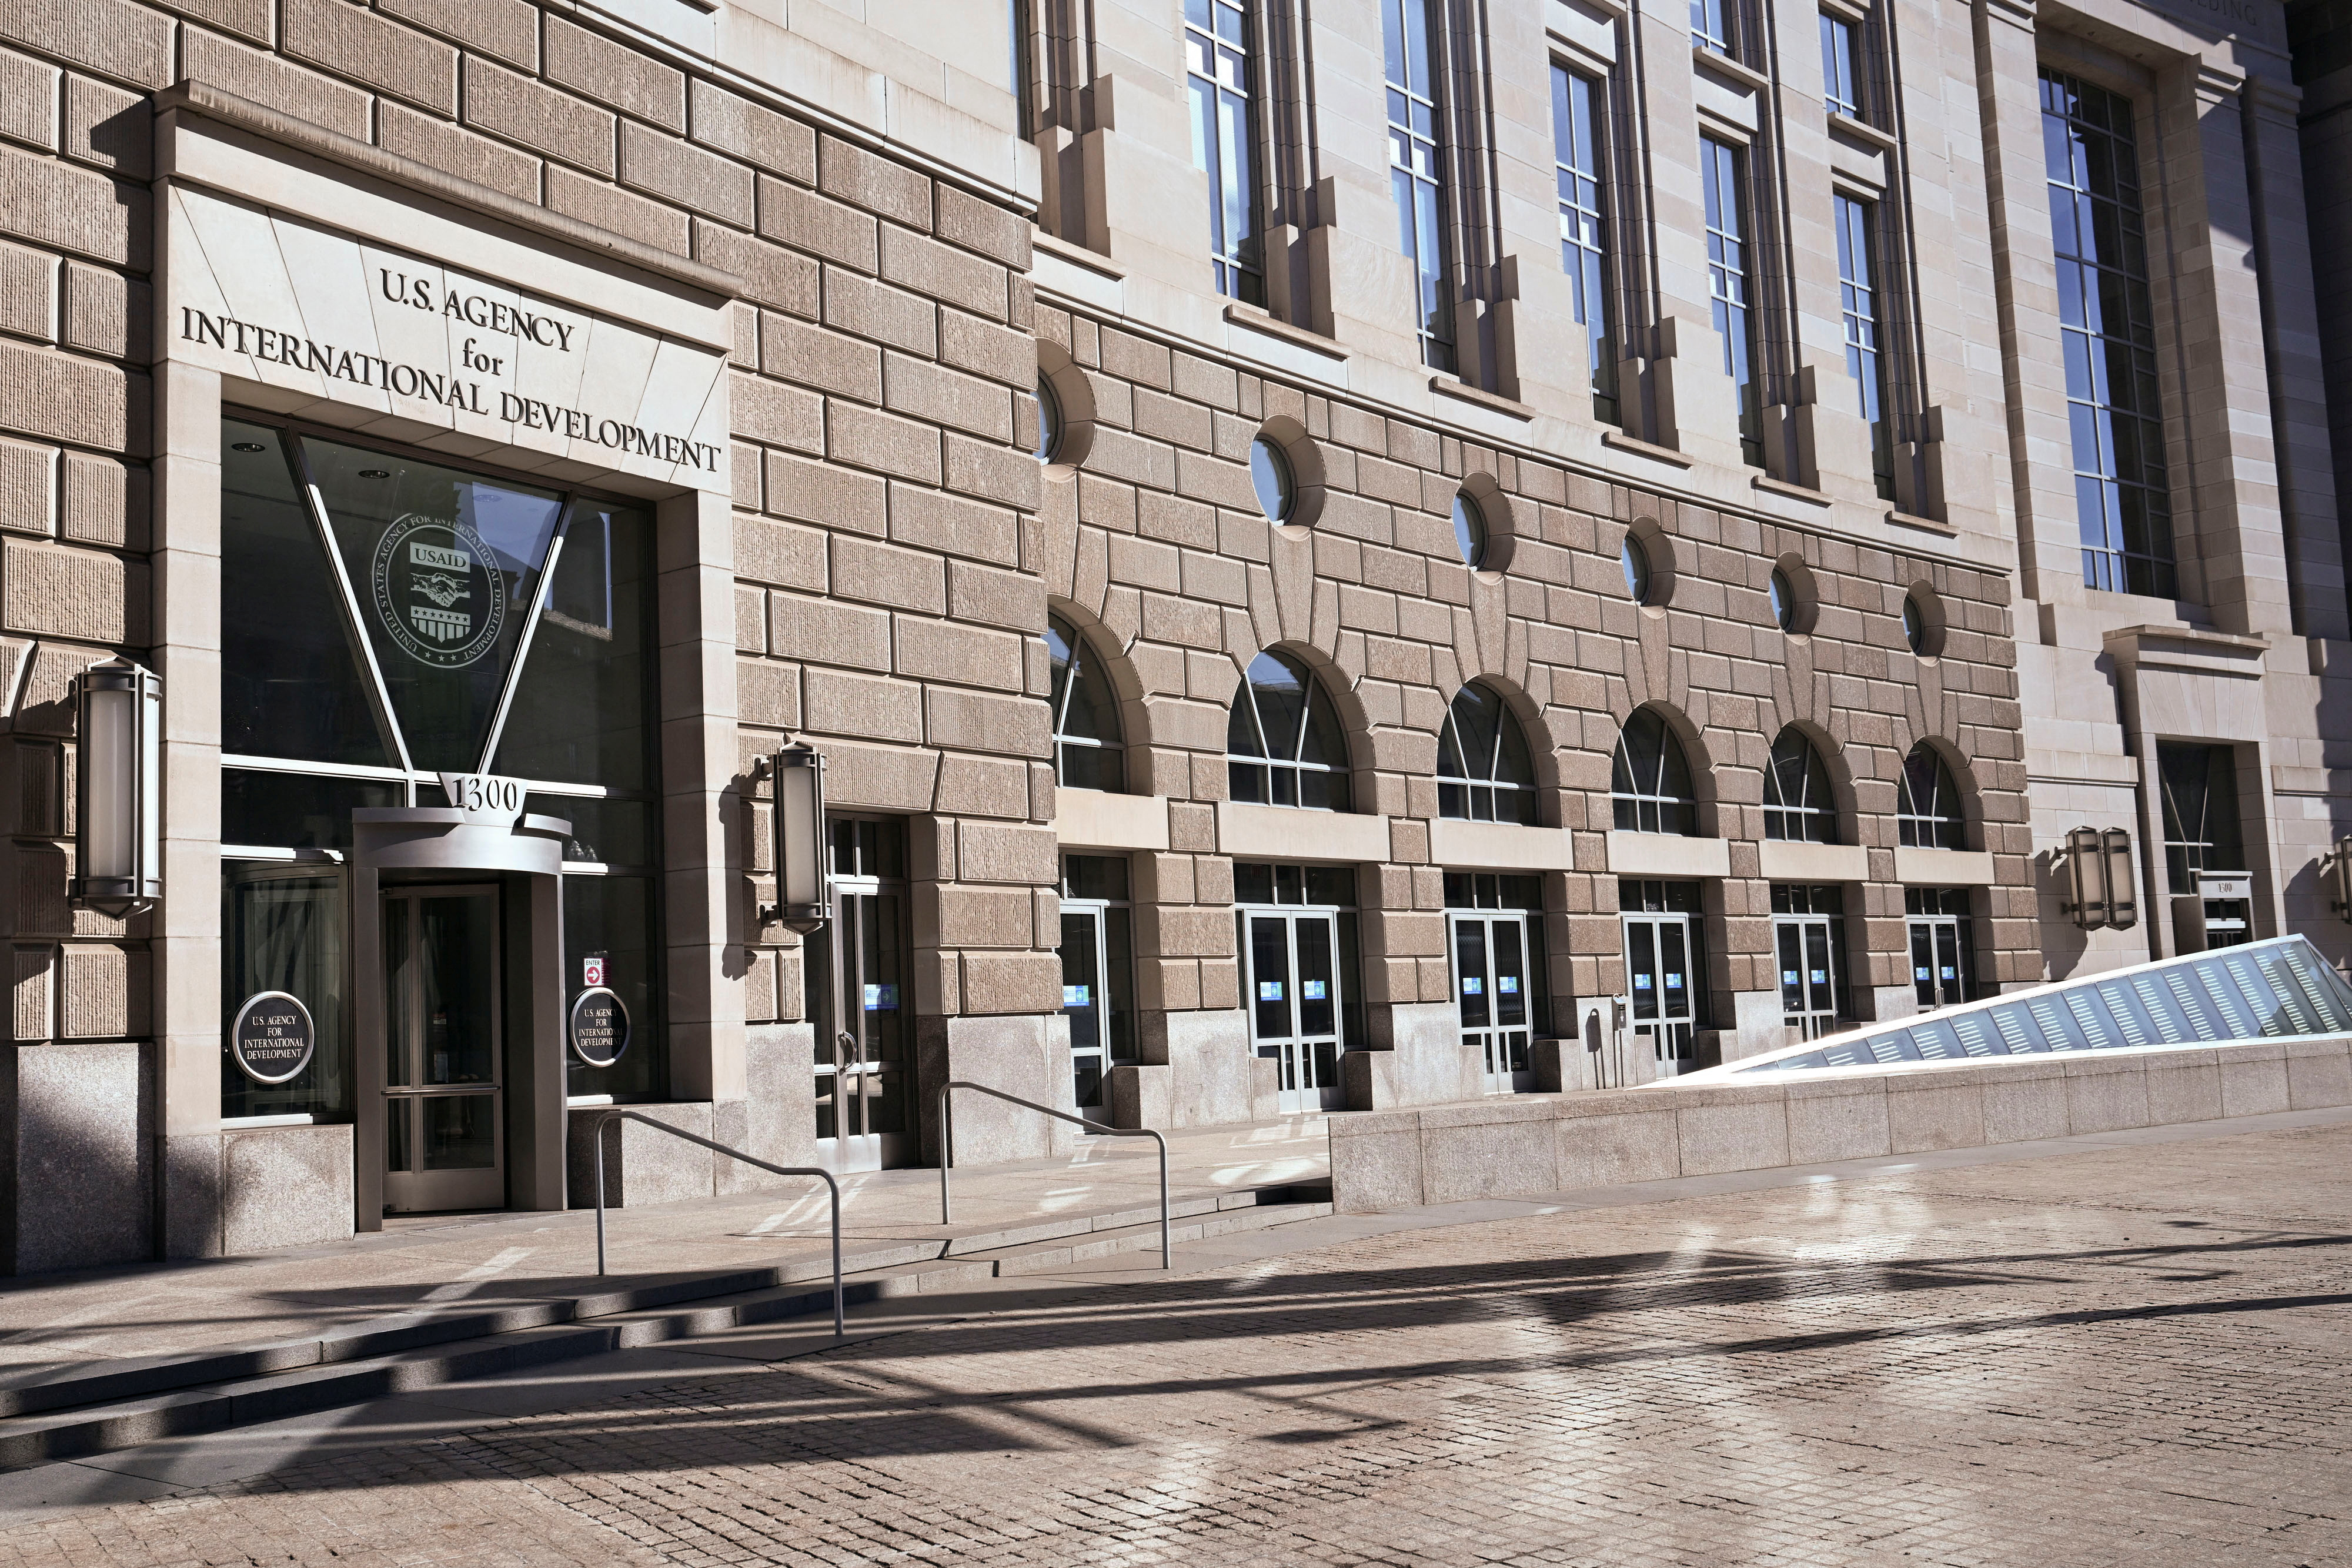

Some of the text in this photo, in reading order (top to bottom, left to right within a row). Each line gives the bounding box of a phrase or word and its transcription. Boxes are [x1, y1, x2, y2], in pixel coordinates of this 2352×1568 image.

[380, 268, 576, 352] U.S. AGENCY
[462, 339, 503, 376] for
[181, 306, 722, 473] INTERNATIONAL DEVELOPMENT
[410, 515, 432, 526] FOR
[381, 521, 407, 559] AGENCY
[414, 547, 466, 568] USAID
[376, 561, 388, 607] STATES
[463, 589, 502, 661] DEVELOPMENT
[385, 611, 417, 653] UNITED
[452, 775, 517, 812] 1300
[2218, 882, 2233, 893] 1300
[584, 1008, 617, 1017] U.S. AGENCY
[252, 1015, 296, 1025] U.S. AGENCY
[596, 1018, 607, 1027] FOR
[267, 1027, 282, 1037] FOR
[579, 1028, 623, 1037] INTERNATIONAL
[245, 1038, 304, 1048] INTERNATIONAL
[580, 1037, 622, 1047] DEVELOPMENT
[247, 1049, 302, 1059] DEVELOPMENT
